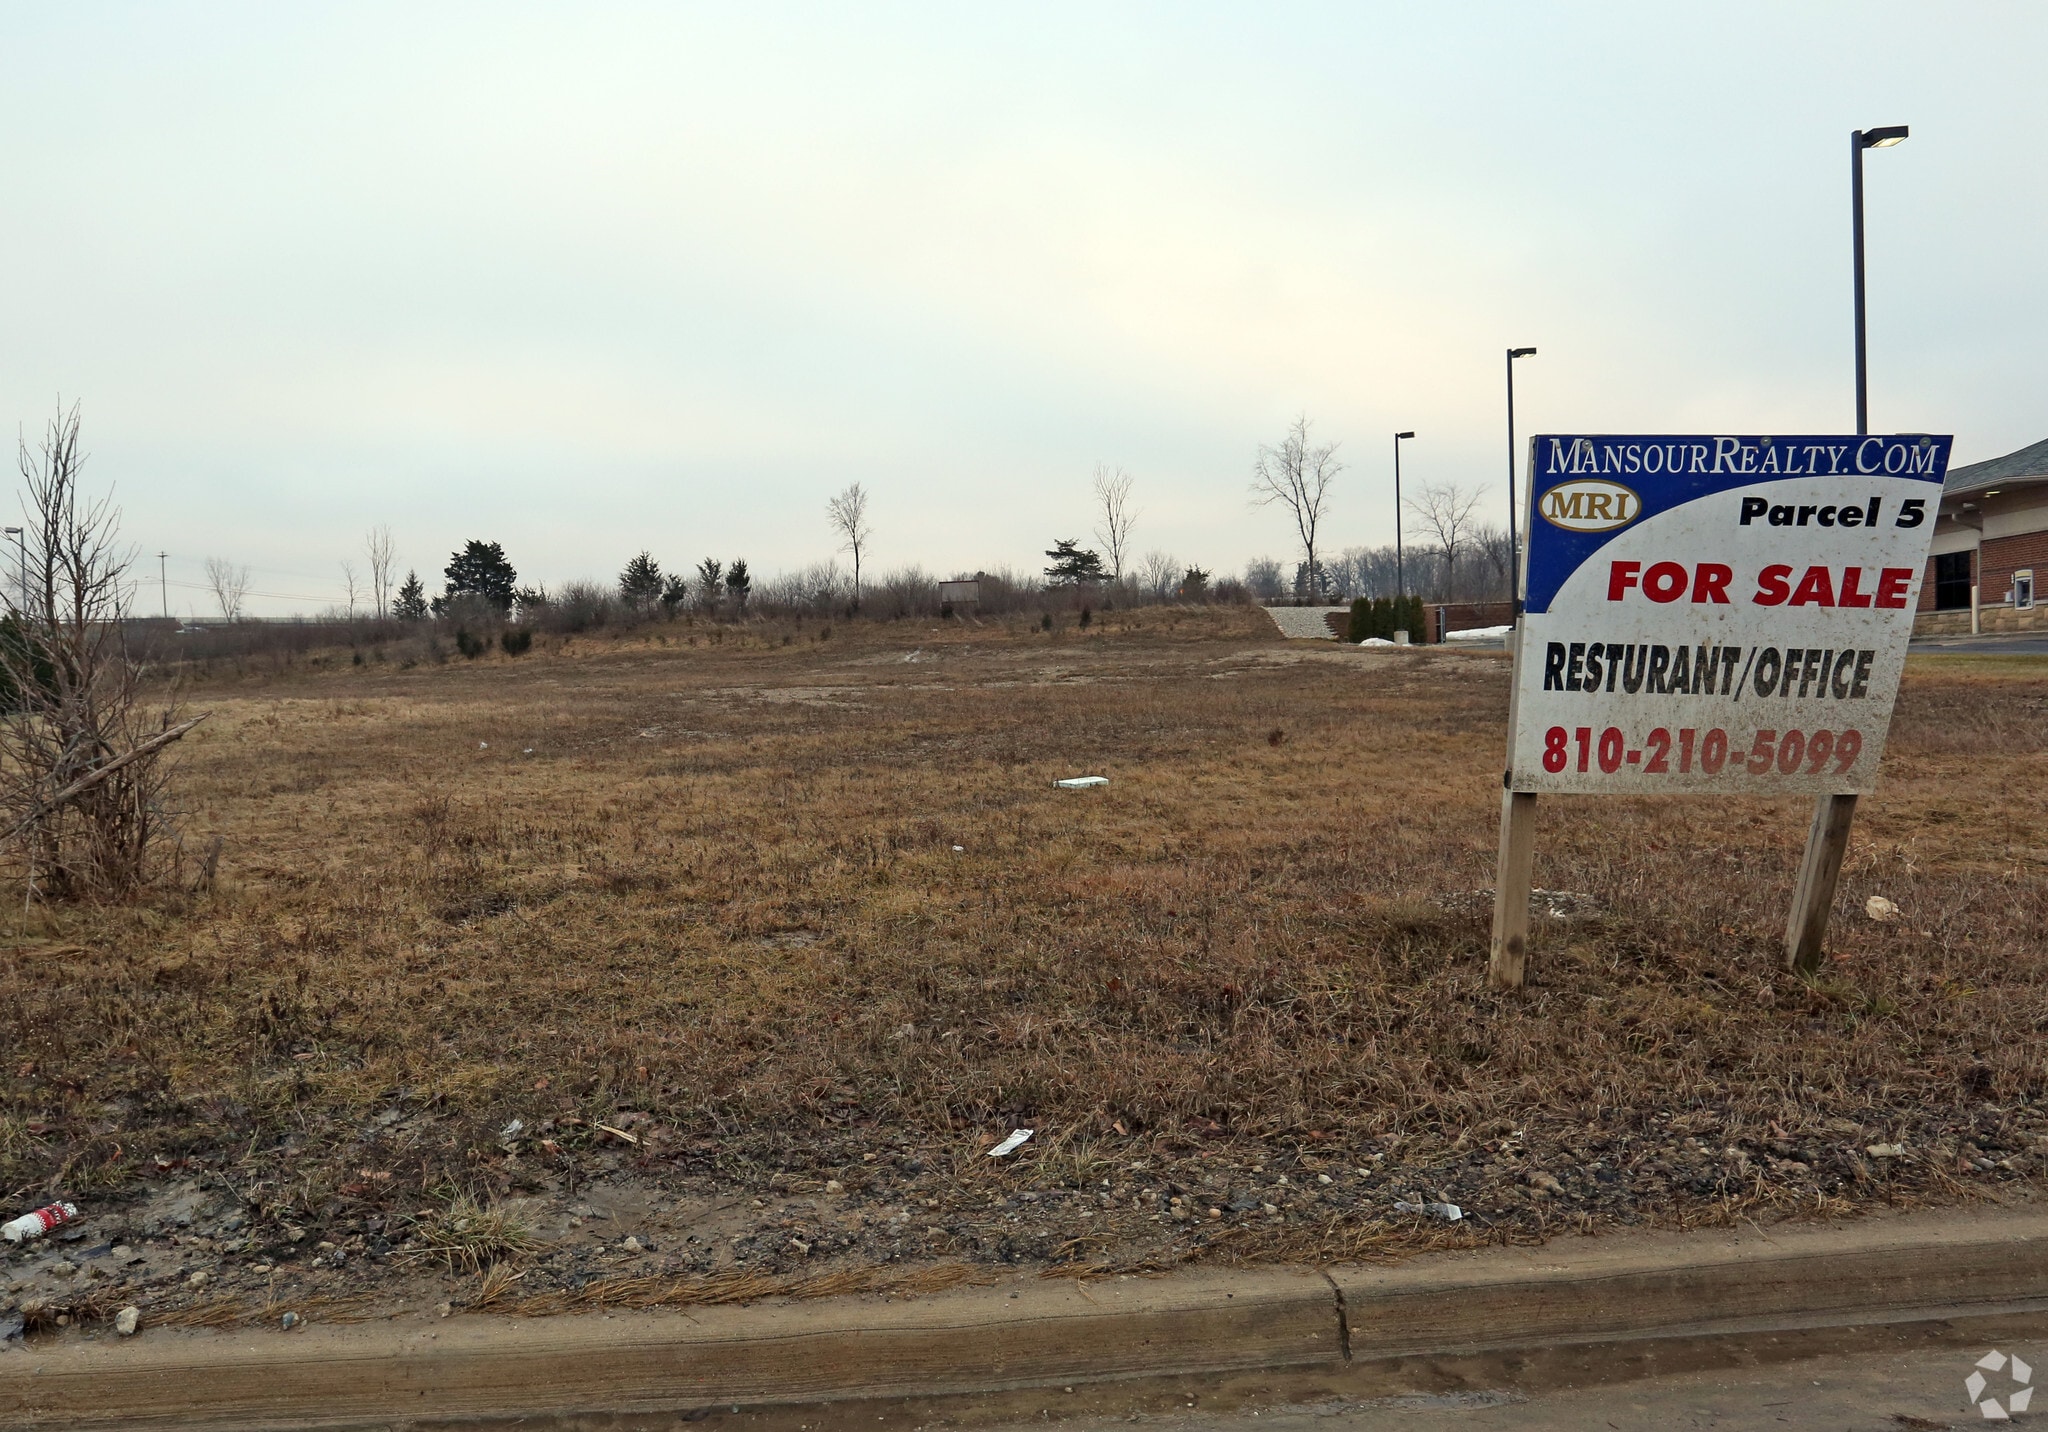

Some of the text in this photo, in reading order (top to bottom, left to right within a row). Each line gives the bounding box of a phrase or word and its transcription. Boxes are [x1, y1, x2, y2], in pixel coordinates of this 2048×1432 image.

[1549, 492, 1629, 520] MRI
[1739, 497, 1926, 528] Parcel 5
[1607, 561, 1914, 608] FOR SALE
[1543, 642, 1876, 701] RESTURANT/OFFICE
[1542, 726, 1863, 774] 810-210-5099
